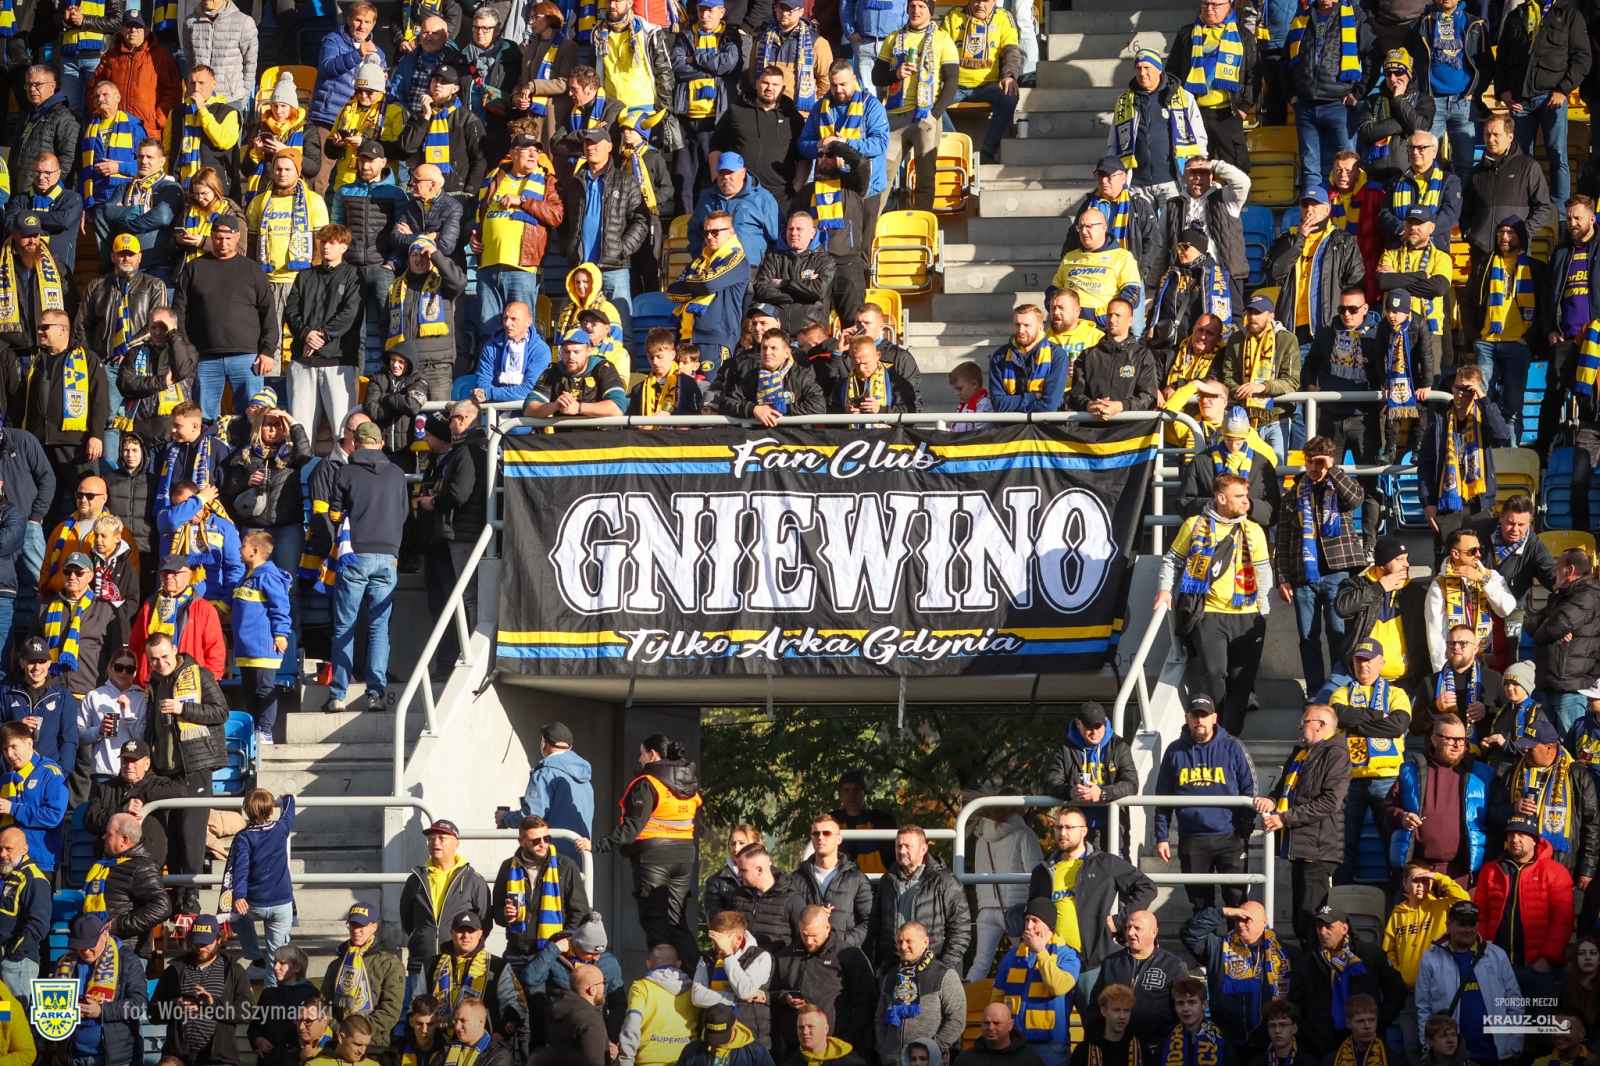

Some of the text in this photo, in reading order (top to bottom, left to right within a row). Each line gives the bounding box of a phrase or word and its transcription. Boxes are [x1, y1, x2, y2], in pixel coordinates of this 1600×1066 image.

[1125, 40, 1141, 53] 16
[1222, 67, 1235, 77] 80
[1091, 118, 1106, 131] 15
[1057, 197, 1073, 210] 14
[1068, 267, 1107, 278] GDYNIA
[1023, 273, 1038, 287] 13
[1076, 281, 1102, 290] Energa
[731, 436, 942, 480] Fan Club
[547, 485, 1119, 616] GNIEWINO
[619, 624, 1022, 665] Tylko Arka Gdynia
[387, 692, 396, 706] 8
[1179, 767, 1227, 786] ARKA
[1267, 775, 1277, 789] 7
[343, 778, 352, 792] 7
[677, 805, 690, 814] 050
[350, 907, 369, 917] ARKA
[192, 924, 213, 934] ARKA
